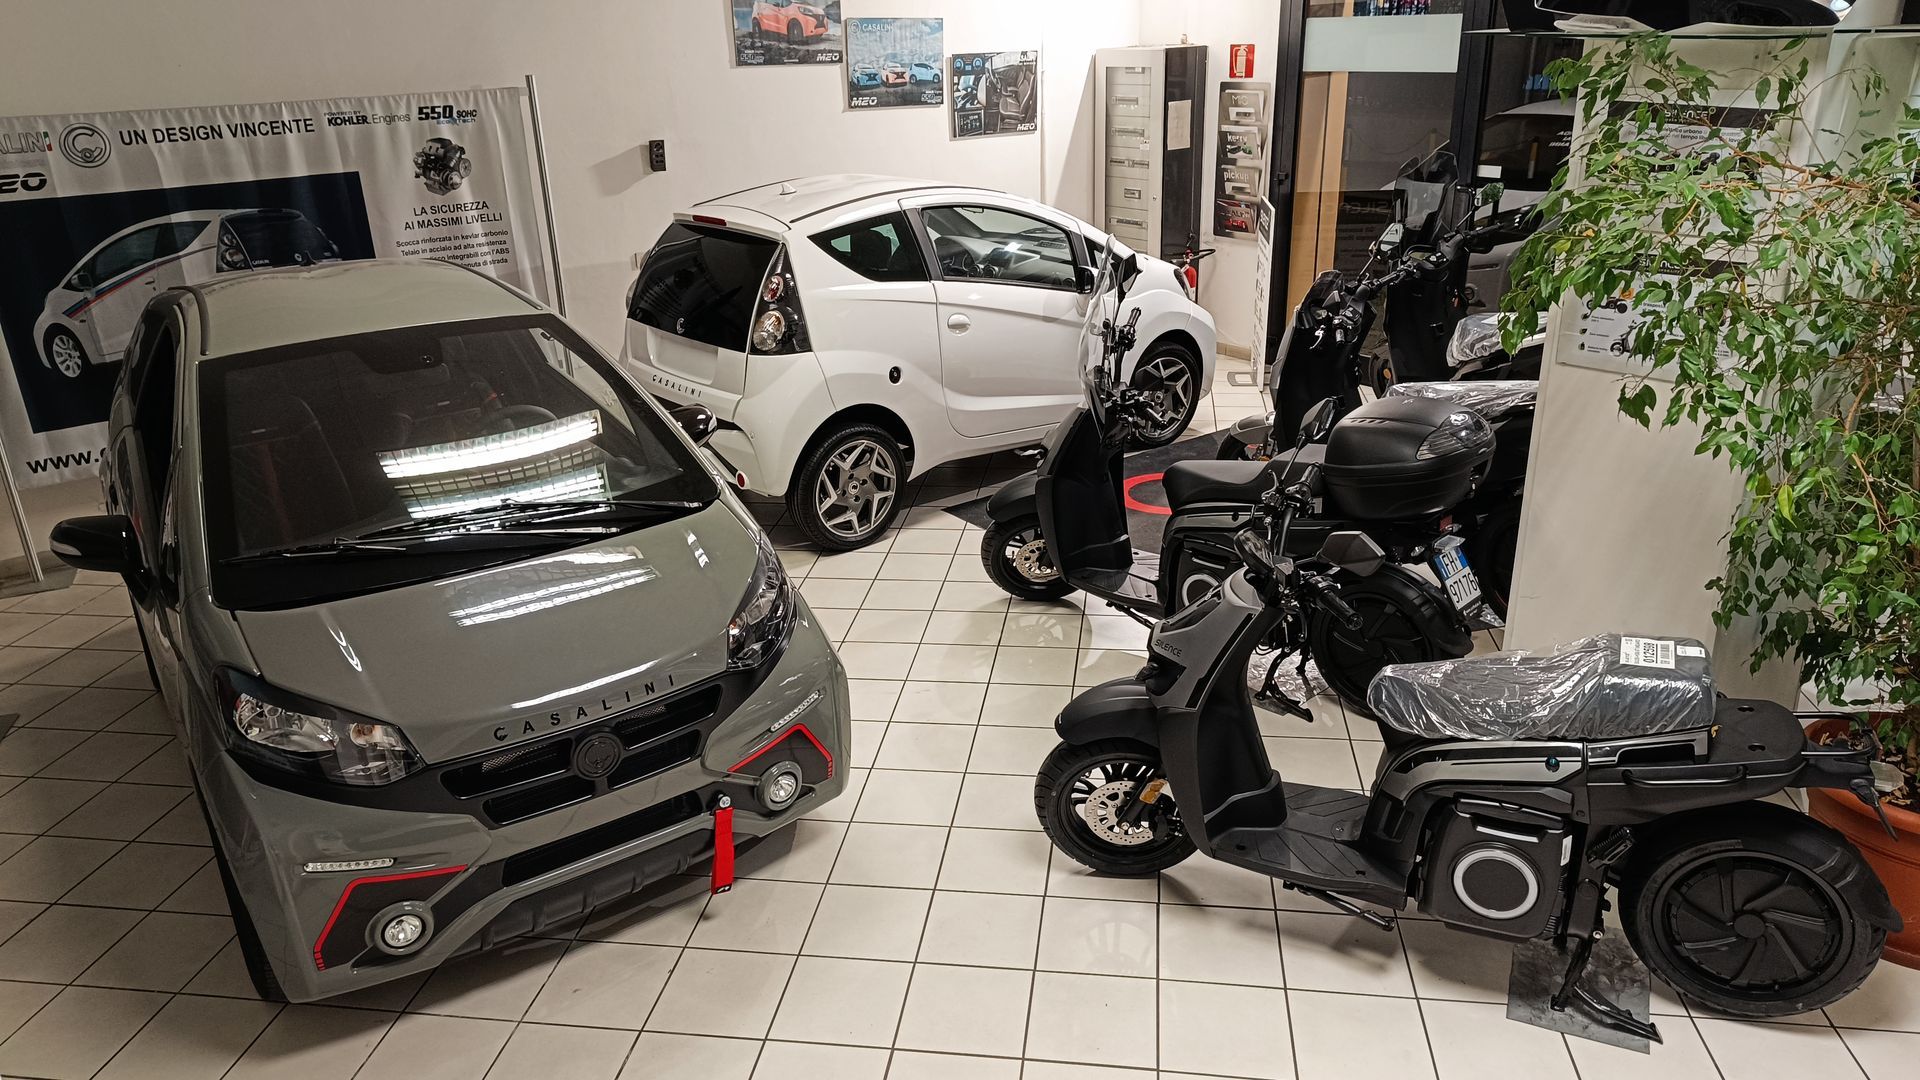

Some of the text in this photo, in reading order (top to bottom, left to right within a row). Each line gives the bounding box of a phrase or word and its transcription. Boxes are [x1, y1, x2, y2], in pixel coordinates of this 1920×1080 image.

[327, 113, 411, 126] KOHLER Engines
[418, 105, 477, 121] 550 SOHC
[119, 118, 315, 146] UN DESIGN VINCENTE
[1223, 170, 1249, 182] pickup
[413, 200, 489, 216] LA SICUREZZA
[404, 213, 503, 231] AI MASSIMI LIVELLI
[396, 239, 420, 248] Scocca
[420, 235, 452, 244] rinforzata
[480, 230, 509, 238] carbonio
[428, 245, 452, 253] acciaio
[463, 242, 475, 250] alta
[475, 240, 507, 248] resistenza
[653, 375, 701, 397] CASALINI
[1442, 551, 1459, 575] FH
[1449, 572, 1478, 603] 97176
[1155, 639, 1182, 657] SILENCE
[493, 675, 674, 741] CASALINI
